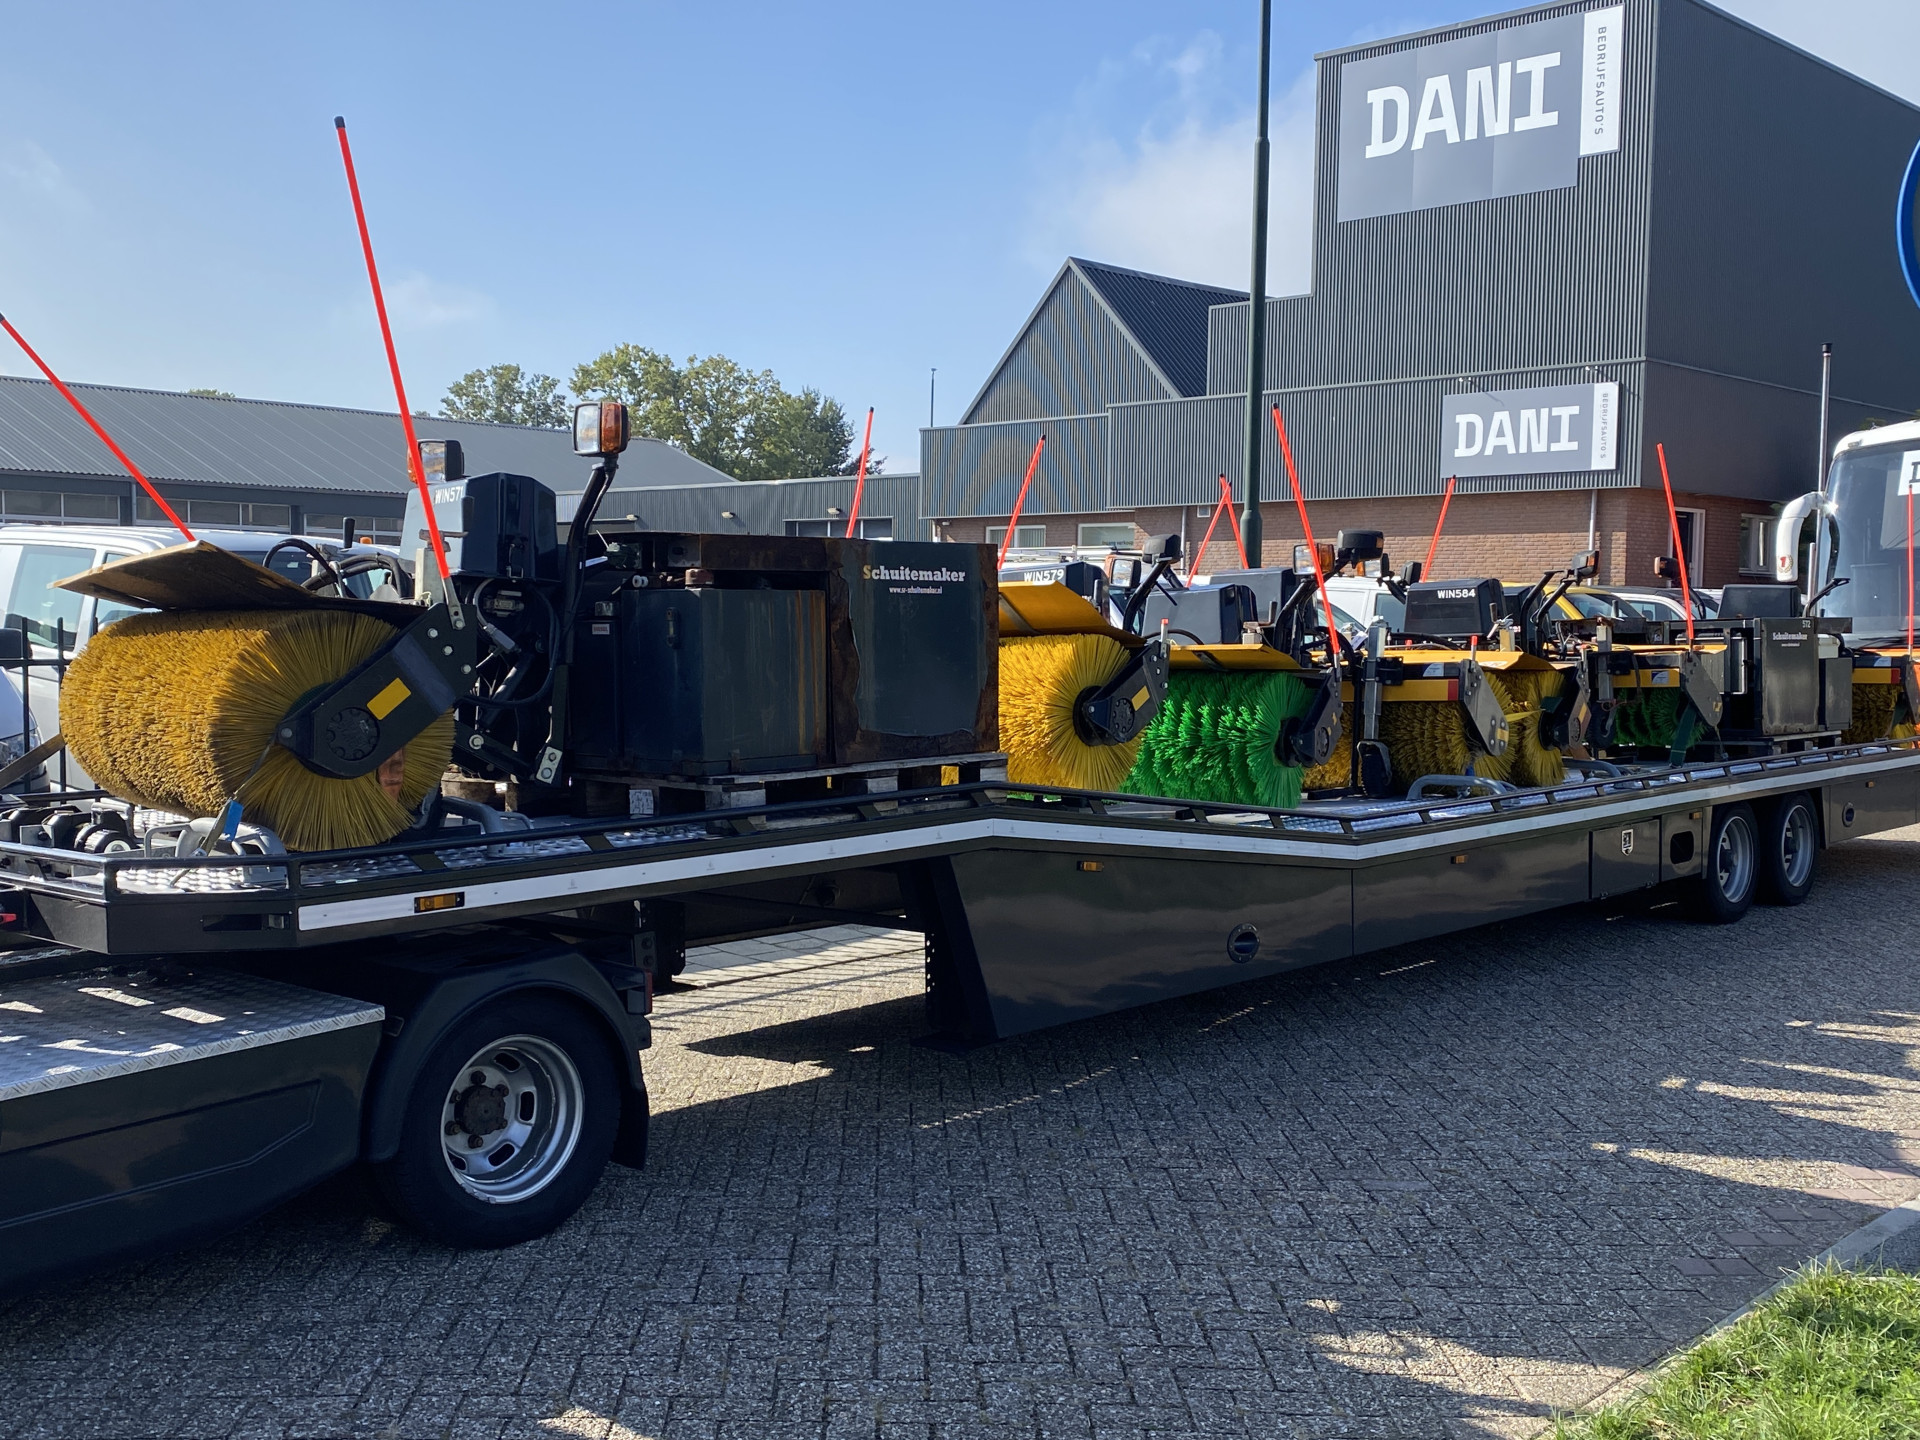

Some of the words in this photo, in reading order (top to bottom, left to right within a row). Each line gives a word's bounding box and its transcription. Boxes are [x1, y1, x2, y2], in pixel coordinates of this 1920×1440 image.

[1595, 26, 1607, 135] BEDRIJFSAUTO'S
[1365, 52, 1560, 159] DANI
[1454, 405, 1580, 458] DANI
[434, 486, 464, 505] WIN571
[863, 565, 966, 582] Schuitemaker
[1023, 569, 1064, 582] WIN579
[1437, 589, 1476, 599] WIN584
